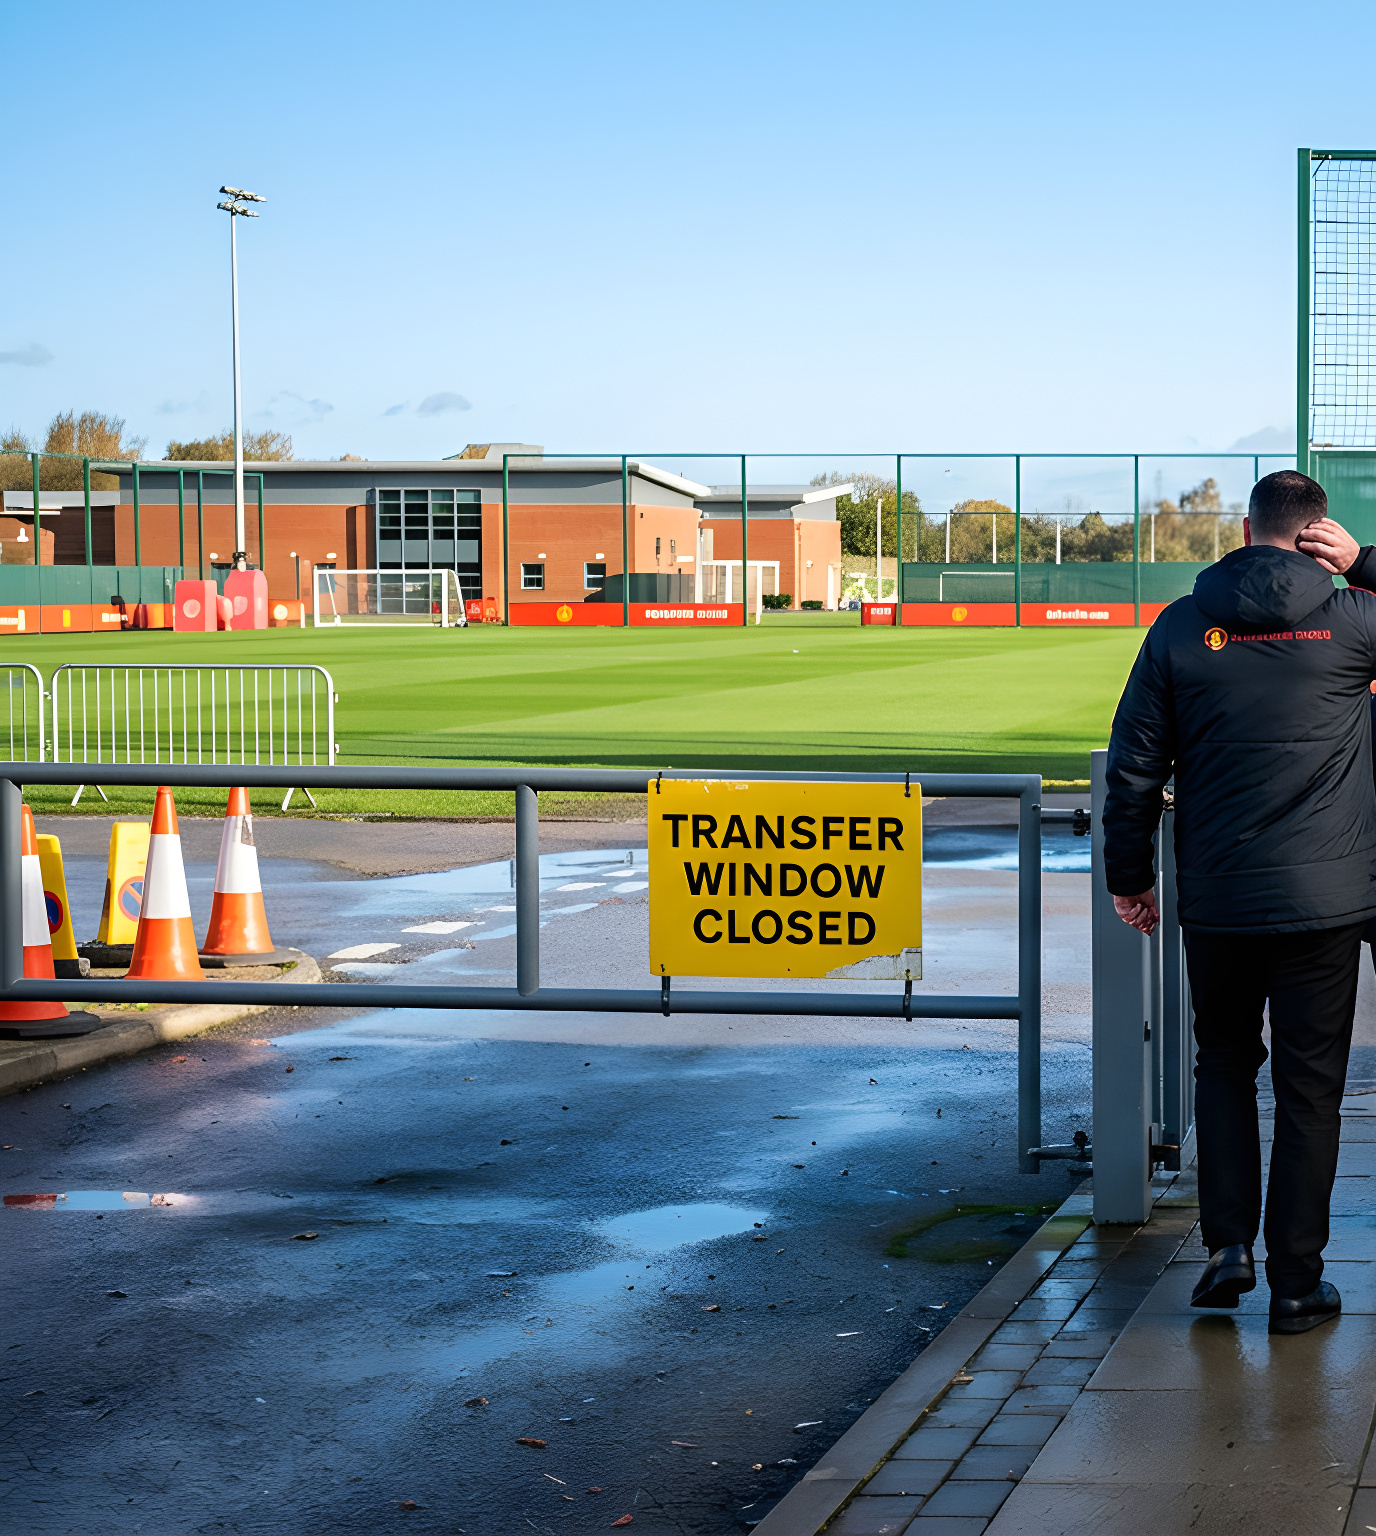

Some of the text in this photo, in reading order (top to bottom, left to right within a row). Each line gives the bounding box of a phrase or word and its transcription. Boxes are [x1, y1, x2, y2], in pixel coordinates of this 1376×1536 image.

[662, 813, 905, 851] TRANSFER
[683, 862, 886, 898] WINDOW
[693, 908, 876, 946] CLOSED
